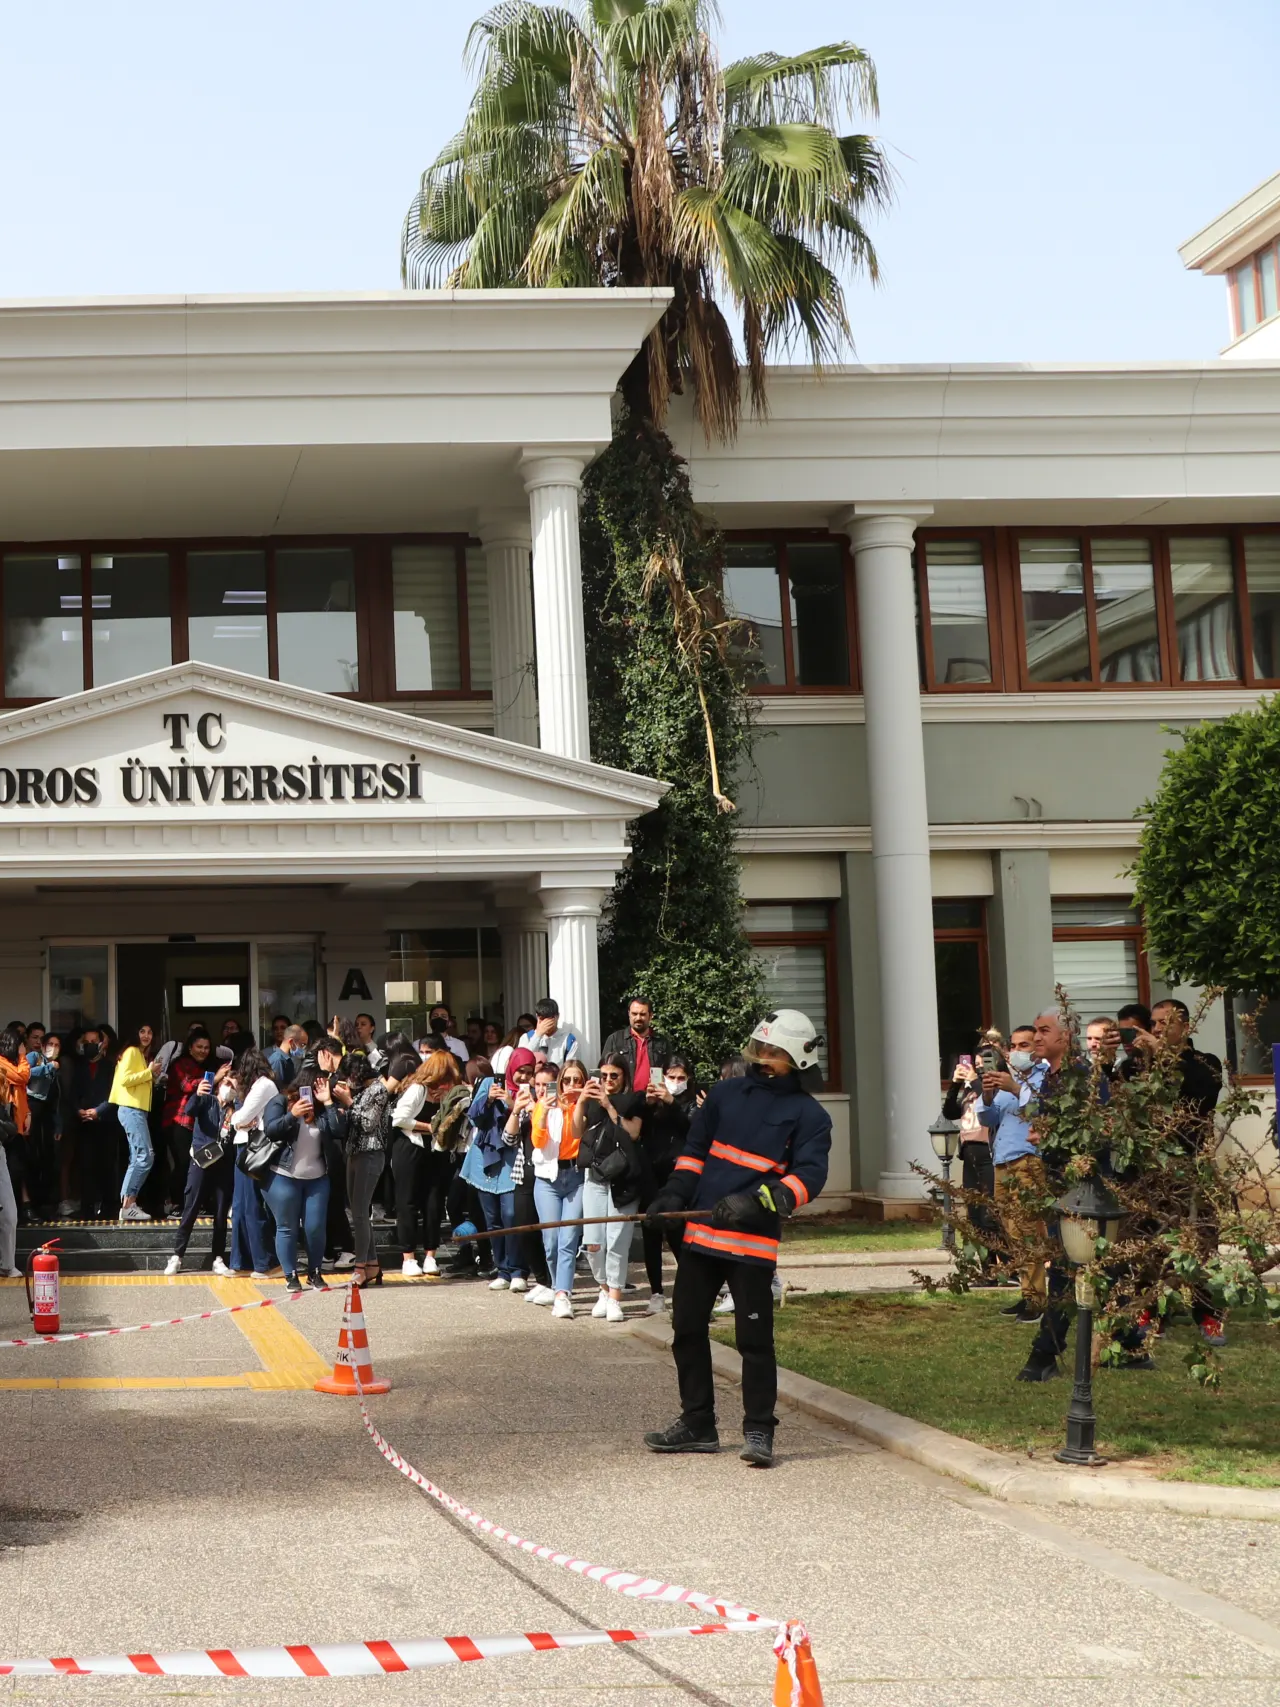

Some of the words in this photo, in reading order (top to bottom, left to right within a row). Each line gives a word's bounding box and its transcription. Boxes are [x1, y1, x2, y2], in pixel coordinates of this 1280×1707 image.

[164, 712, 223, 750] TC
[120, 754, 422, 804] ÜNİVERSİTESİ
[338, 968, 373, 1001] A
